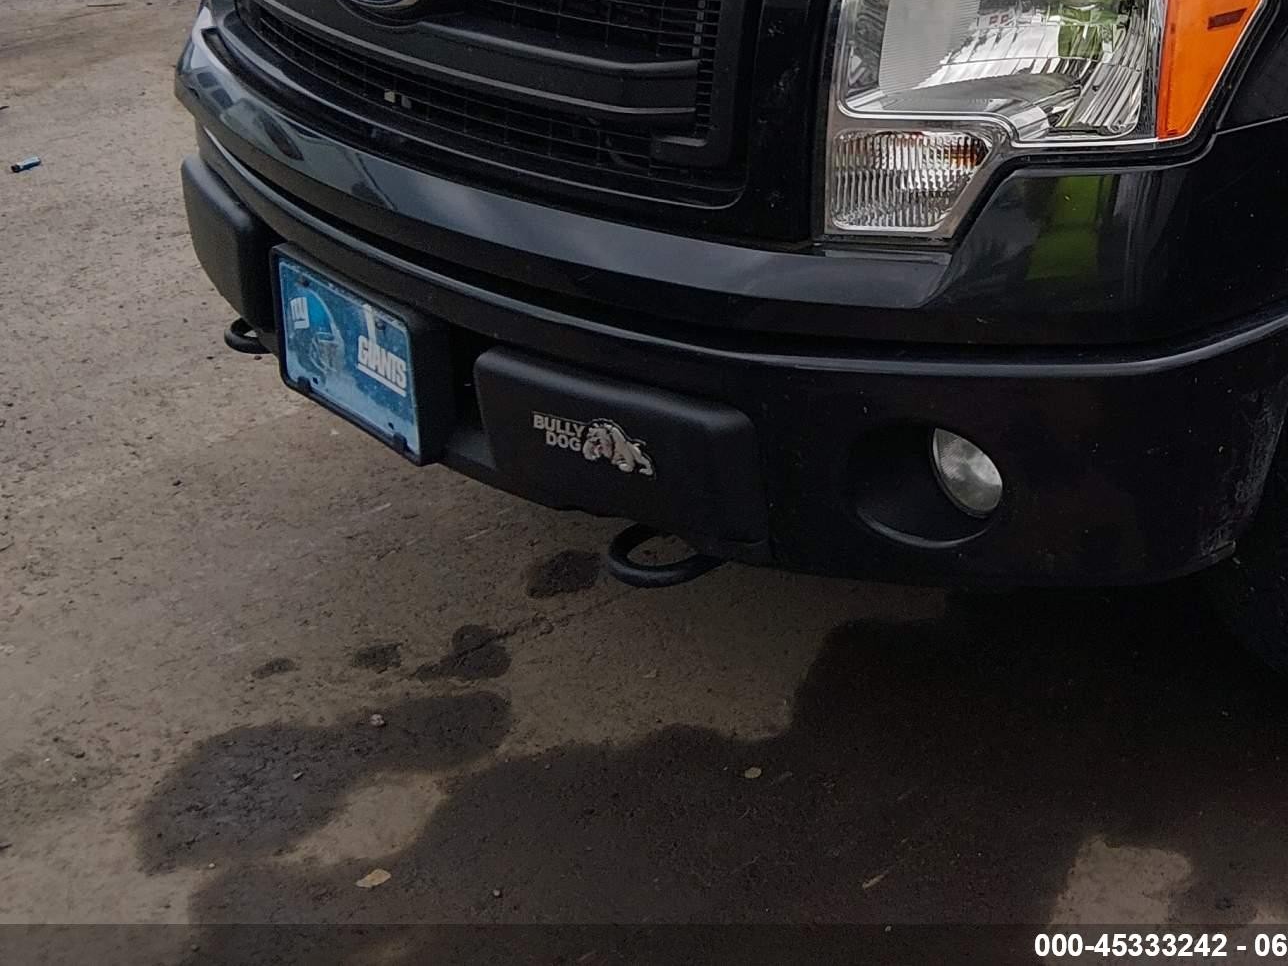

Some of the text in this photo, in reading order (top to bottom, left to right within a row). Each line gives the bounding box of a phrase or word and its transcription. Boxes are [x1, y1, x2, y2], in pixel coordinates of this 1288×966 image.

[357, 334, 408, 390] GIANTS
[532, 414, 586, 438] BULLY
[545, 430, 582, 452] DOG
